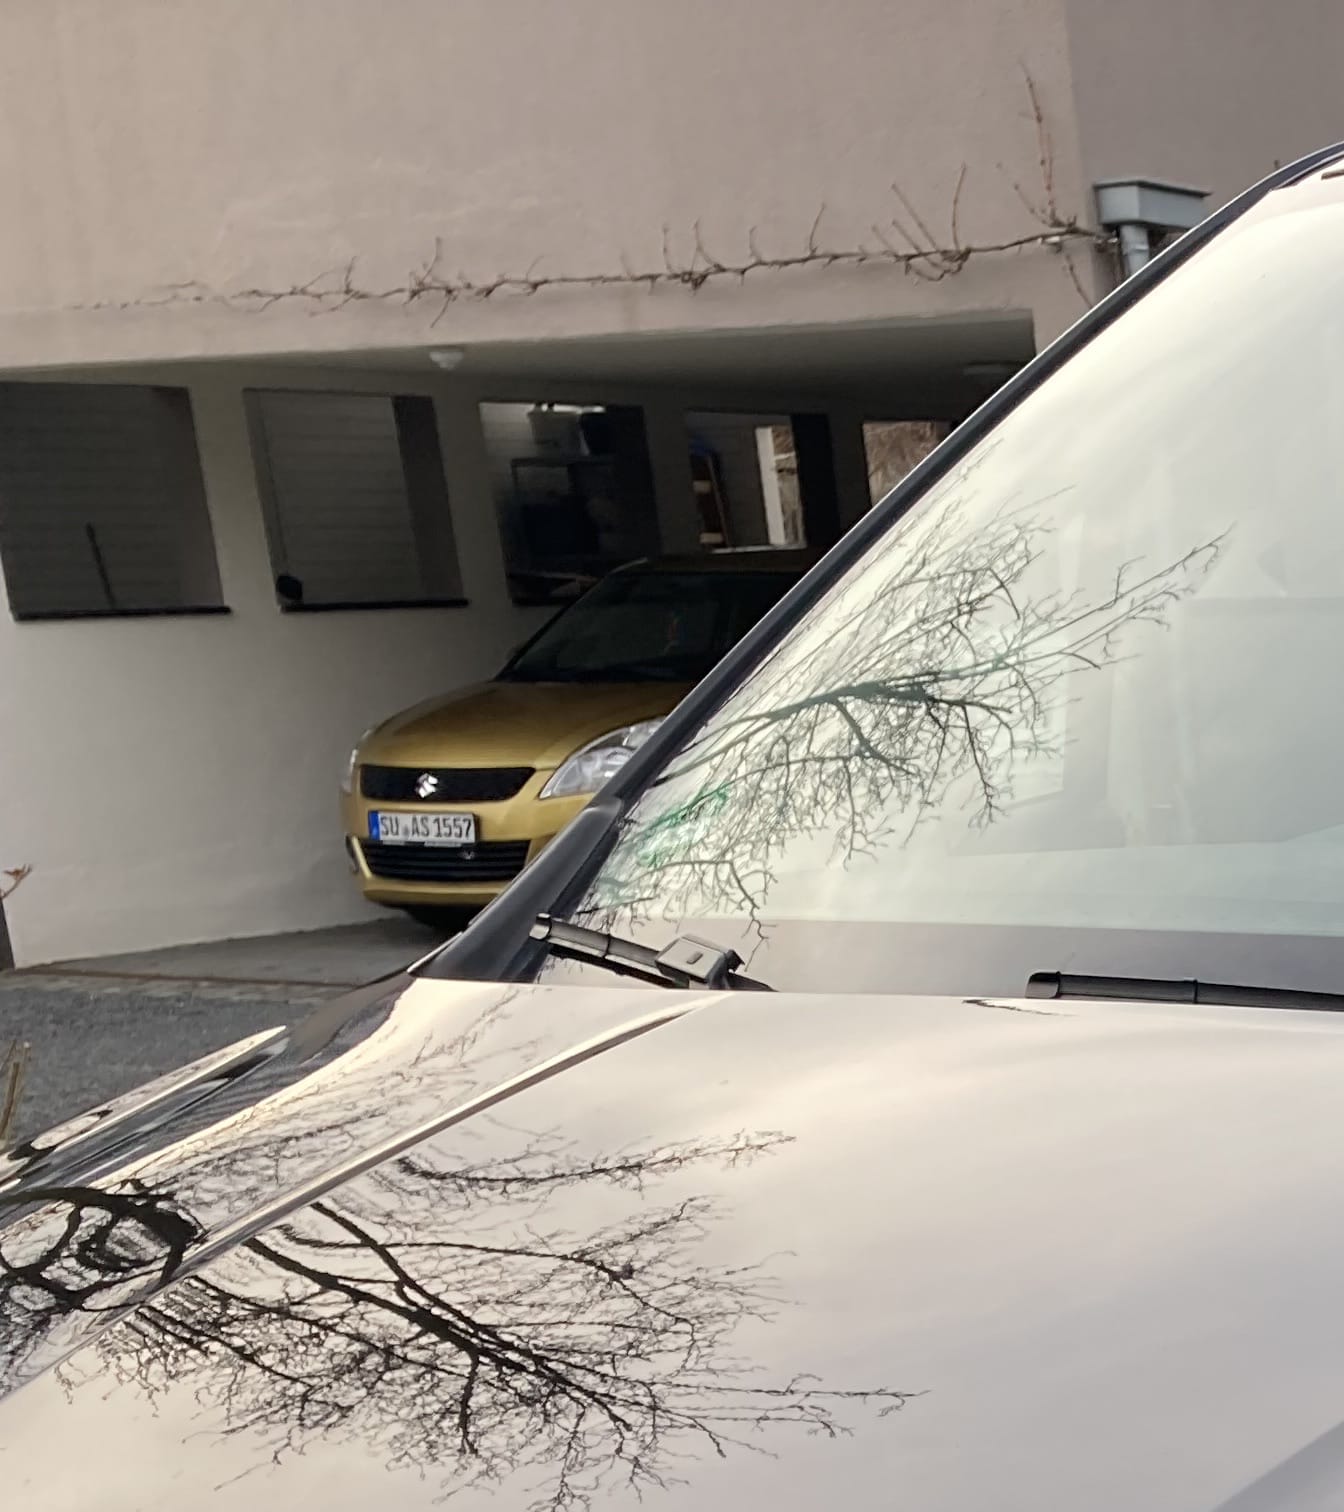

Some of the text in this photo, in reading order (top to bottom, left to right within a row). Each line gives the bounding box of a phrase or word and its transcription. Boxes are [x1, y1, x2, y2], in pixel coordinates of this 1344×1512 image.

[380, 816, 472, 839] SU AS 1557
